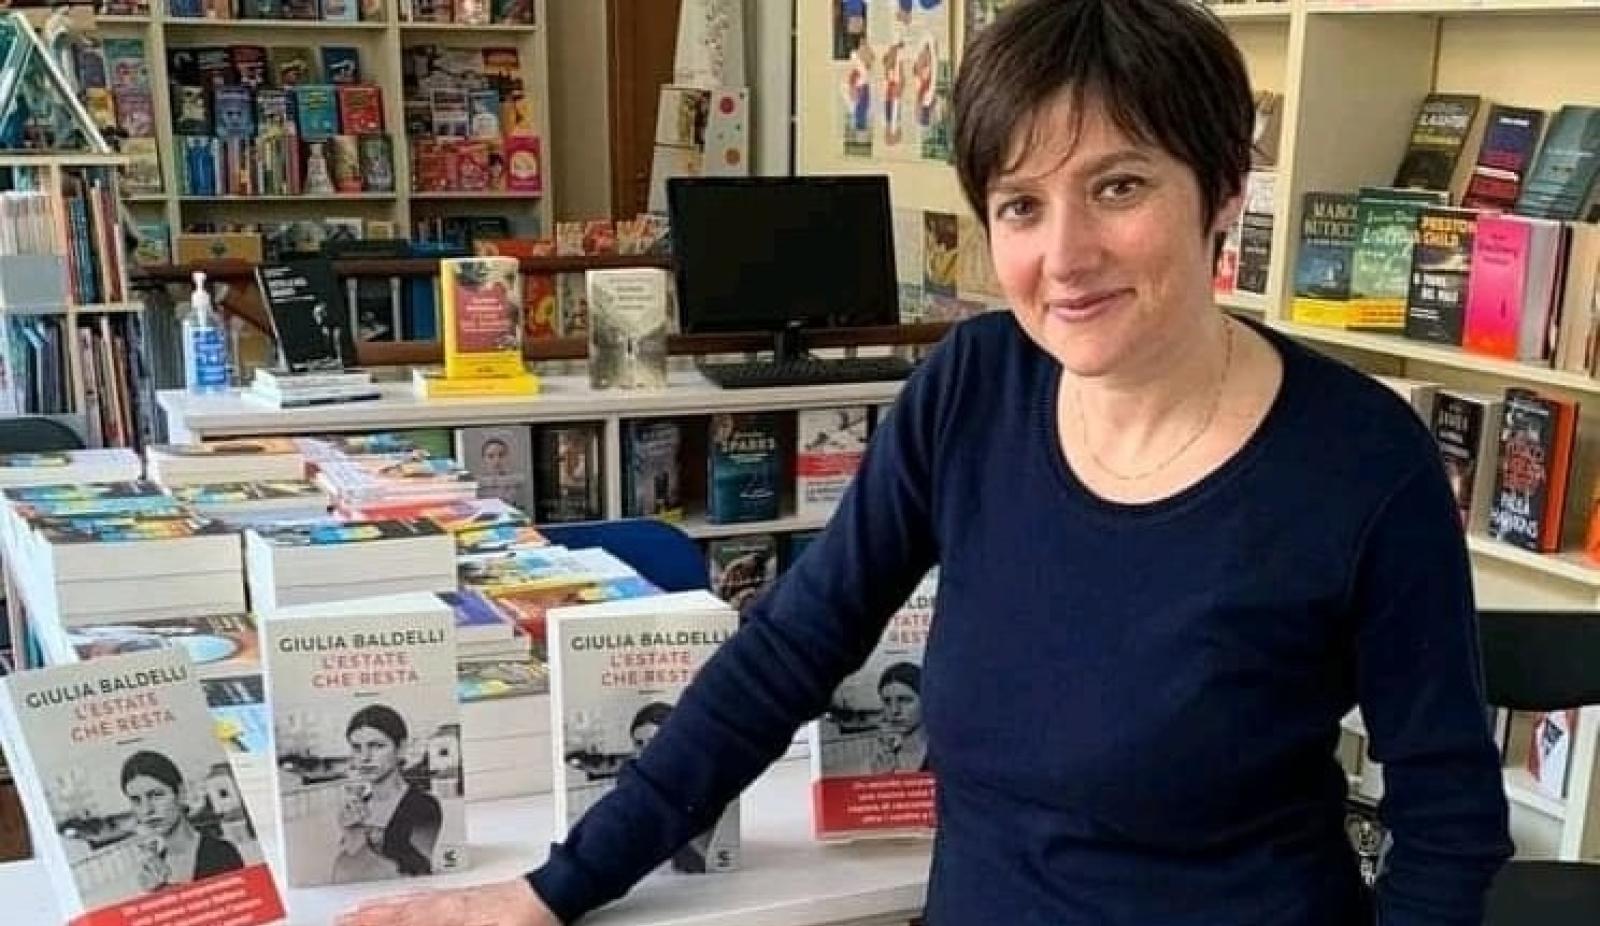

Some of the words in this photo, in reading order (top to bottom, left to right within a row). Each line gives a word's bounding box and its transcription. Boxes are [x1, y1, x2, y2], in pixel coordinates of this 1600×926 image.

[278, 633, 347, 652] GIULIA
[353, 627, 445, 648] BALDELLI
[571, 633, 635, 651] GIULIA
[322, 650, 409, 670] L'ESTATE
[610, 651, 690, 668] L'ESTATE
[26, 682, 95, 709] GIULIA
[99, 663, 188, 694] BALDELLI
[312, 672, 354, 688] CHE
[360, 668, 419, 686] RESTA
[602, 671, 638, 687] CHE
[643, 668, 689, 683] REST
[74, 691, 158, 721] L'ESTATE
[71, 721, 113, 742] CHE
[116, 709, 176, 732] RESTA
